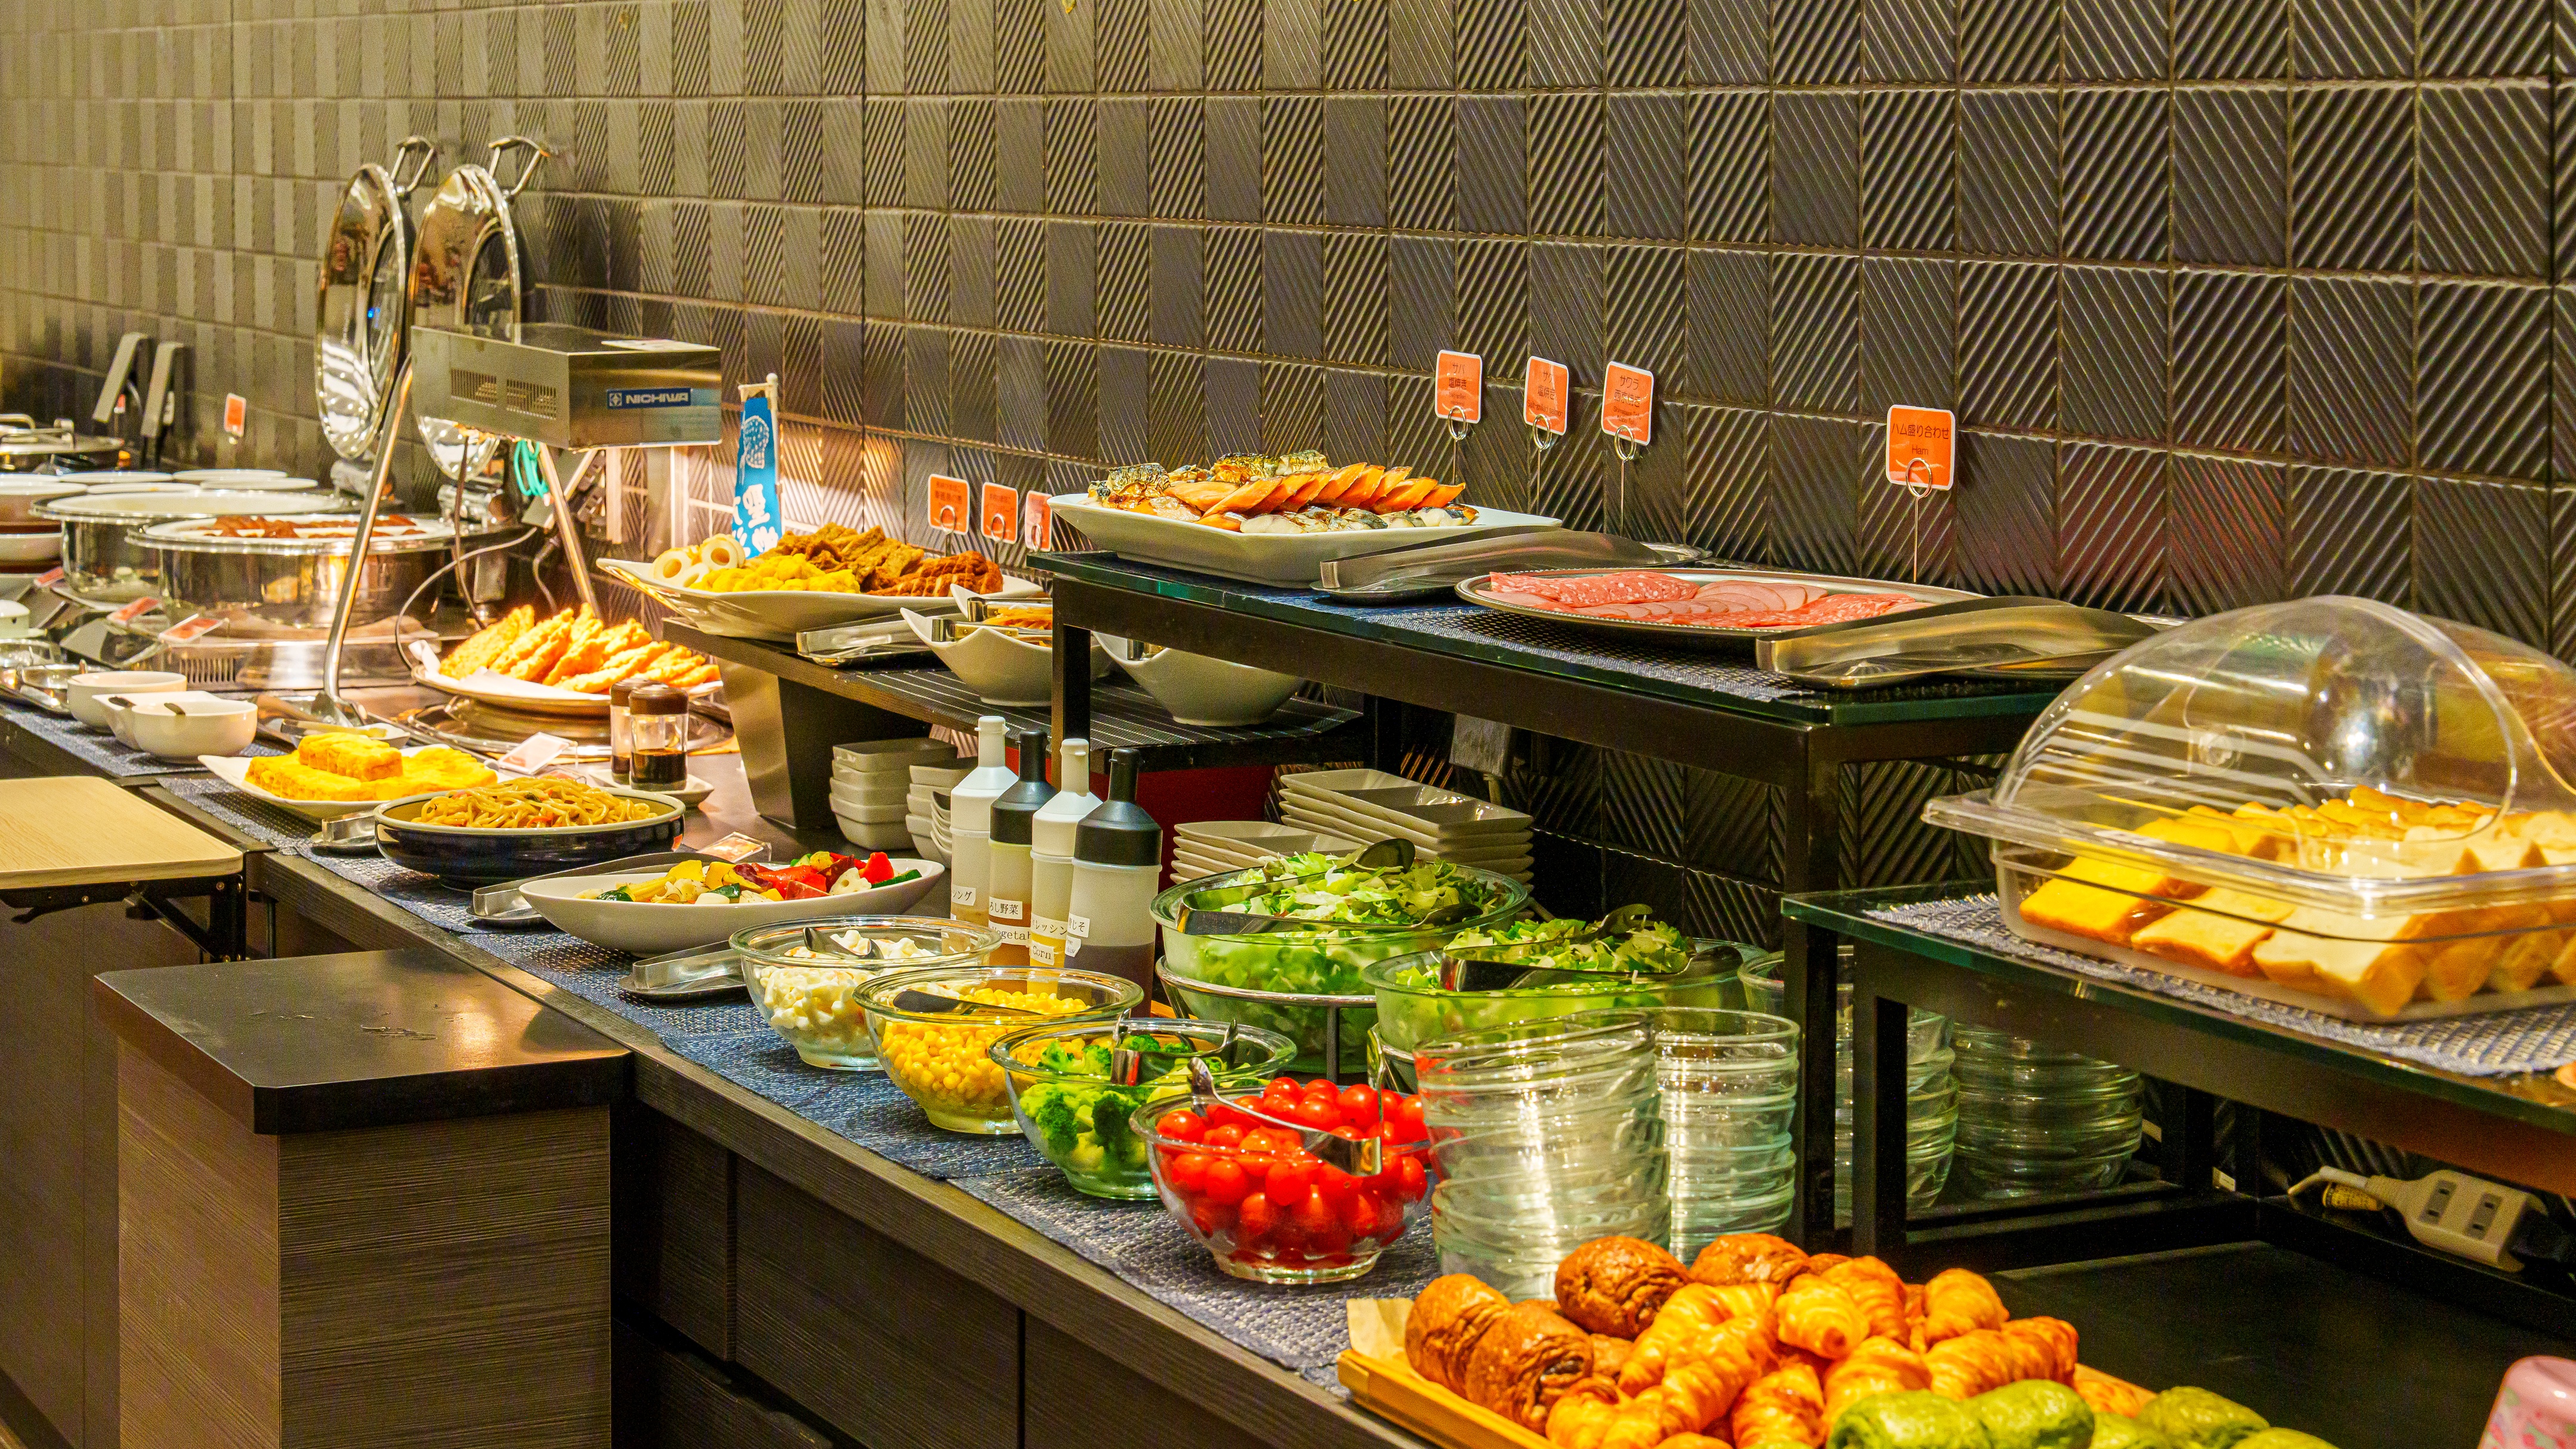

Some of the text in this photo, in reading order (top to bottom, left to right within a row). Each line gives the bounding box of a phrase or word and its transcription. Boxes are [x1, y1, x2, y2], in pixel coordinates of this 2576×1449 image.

[1452, 363, 1465, 373] サバ
[1620, 375, 1639, 390] サワラ
[625, 393, 689, 404] NICHIWA
[1538, 385, 1556, 400] 塩焼き
[1614, 389, 1641, 407] 西京焼き
[1891, 423, 1949, 440] ハム盛り合わせ
[1912, 444, 1929, 455] Ham
[989, 901, 1019, 915] ろし野菜
[1032, 945, 1052, 960] Corn
